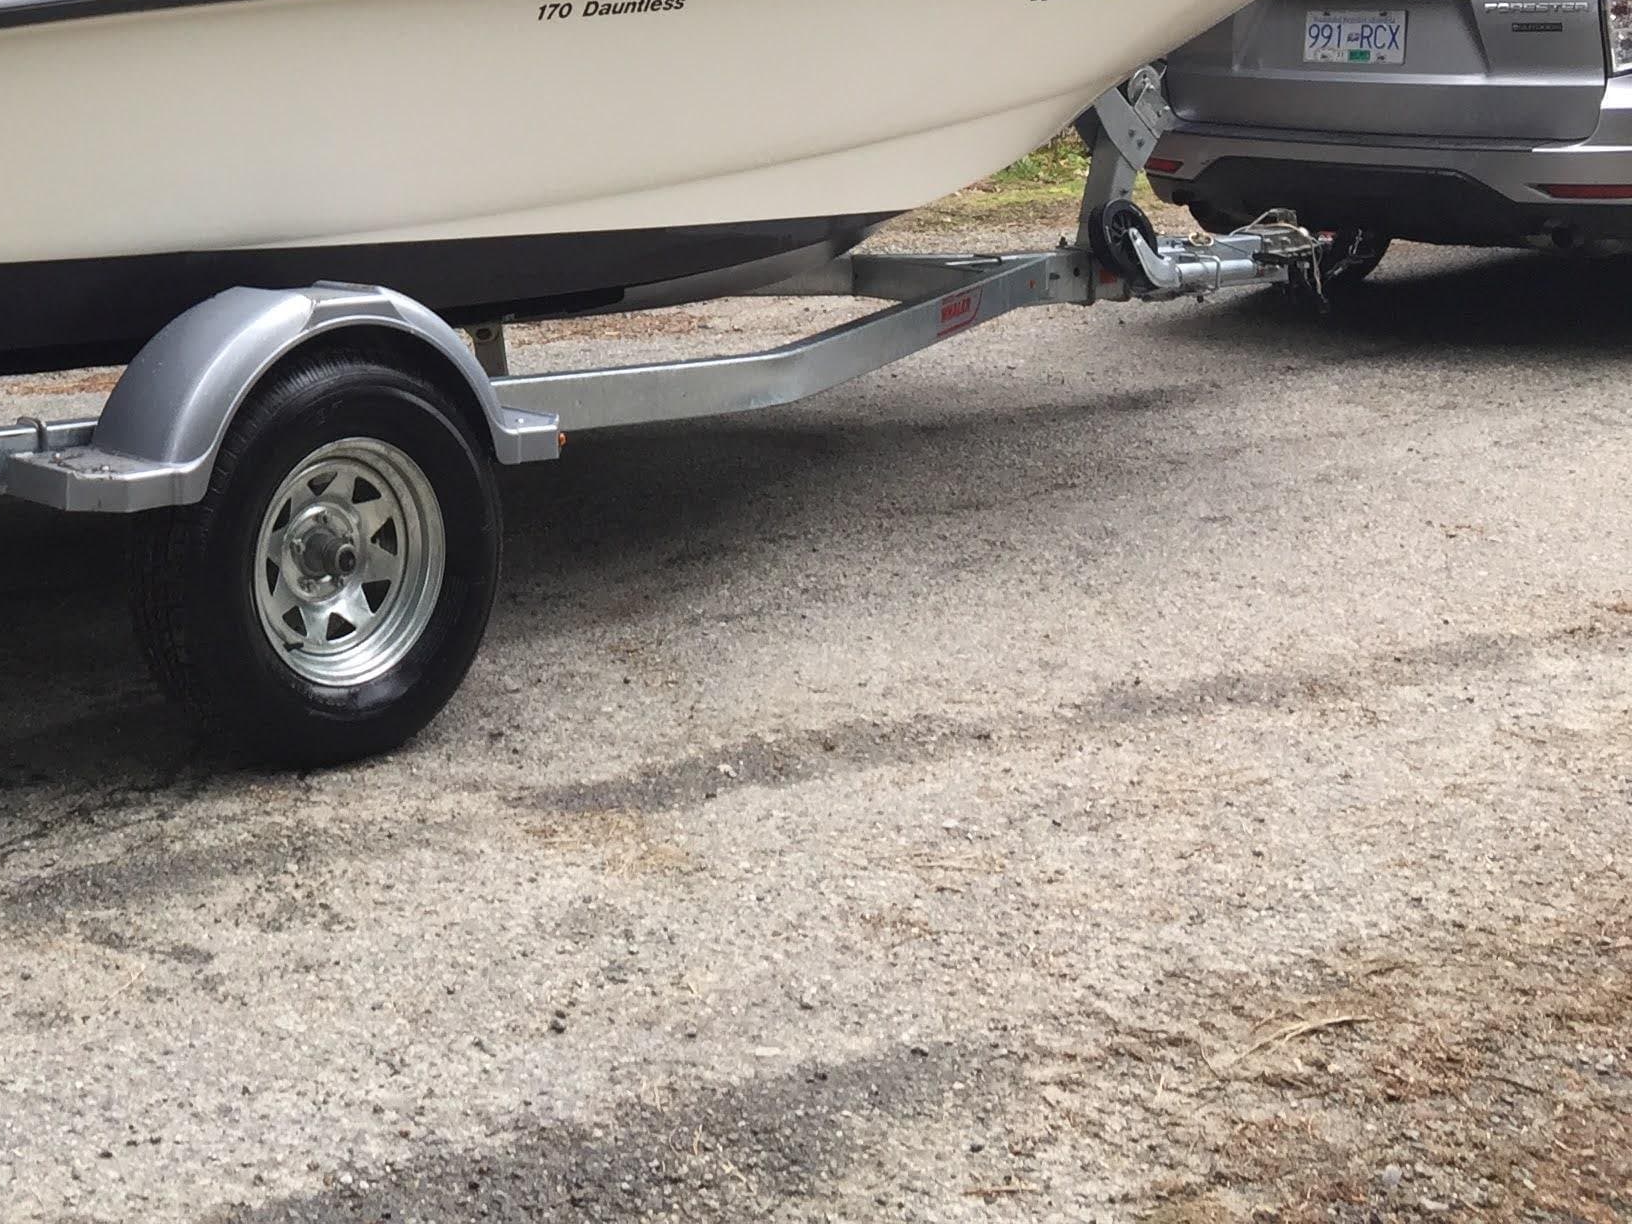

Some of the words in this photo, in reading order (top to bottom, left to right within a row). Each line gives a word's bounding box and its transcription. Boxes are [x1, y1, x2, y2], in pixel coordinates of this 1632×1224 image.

[537, 2, 572, 21] 170
[1308, 23, 1342, 49] 991
[1359, 23, 1401, 50] RCX
